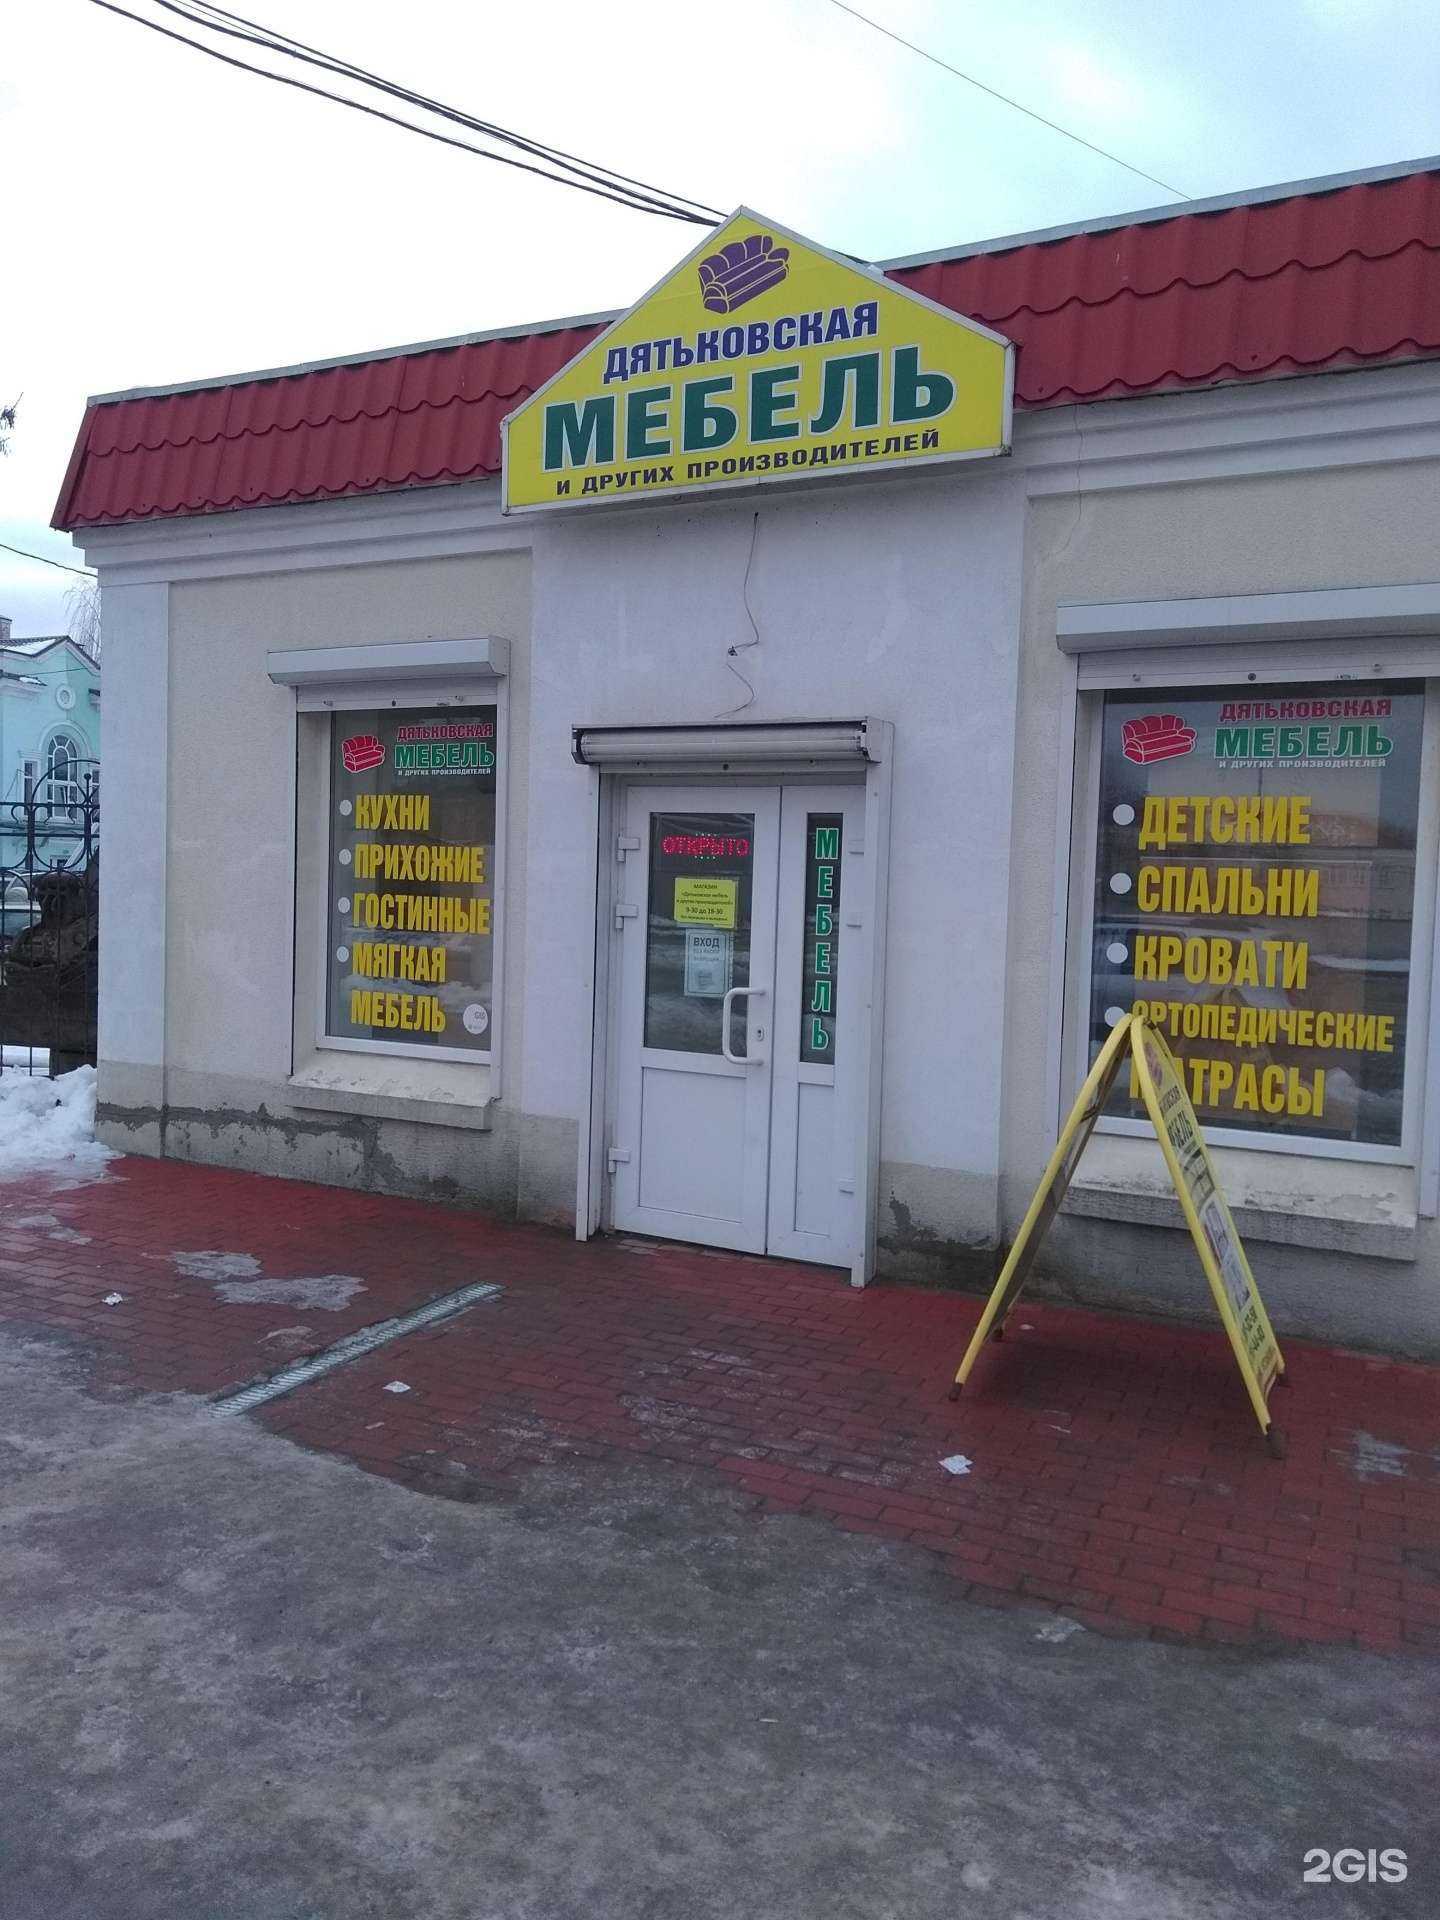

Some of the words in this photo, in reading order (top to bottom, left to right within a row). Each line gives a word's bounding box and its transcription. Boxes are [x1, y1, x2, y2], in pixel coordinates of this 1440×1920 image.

[603, 301, 880, 385] ДЯТЬКОВСКАЯ
[544, 345, 956, 472] МЕБЕЛЬ
[556, 480, 571, 496] И
[581, 465, 675, 495] ДРУГИХ
[686, 428, 940, 479] ПРОИЗВОДИТЕЛЕЙ
[1220, 697, 1393, 723] ДЯТЬКОВСКАЯ
[397, 723, 494, 742] ДЯТЬКОВСКАЯ
[1214, 724, 1394, 759] МЕБЕЛЬ
[394, 742, 495, 769] МЕБЕЛЬ
[404, 768, 430, 777] ДРУГИХ
[431, 767, 491, 776] ПРОИЗВОДИТЕЛЕЙ
[1219, 760, 1227, 768] И
[1230, 759, 1275, 769] ДРУГИХ
[1278, 757, 1387, 769] ПРОИЗВОДИТЕЛЕЙ
[355, 794, 430, 831] КУХНИ
[1138, 796, 1312, 851] ДЕТСКИЕ
[354, 843, 485, 883] ПРИХОЖИЕ
[662, 835, 750, 856] ОТКРЫТО
[1137, 865, 1319, 917] СПАЛЬНИ
[352, 893, 491, 934] ГОСТИННЫЕ
[693, 937, 720, 949] ВХОД
[811, 827, 839, 1050] МЕБЕЛЬ
[352, 942, 447, 983] МЯГКАЯ
[1133, 935, 1308, 990] КРОВАТИ
[350, 989, 447, 1033] МЕБЕЛЬ
[1131, 1000, 1395, 1053] ОРТОПЕДИЧЕСКИЕ
[1129, 1056, 1326, 1118] ТРАСЫ
